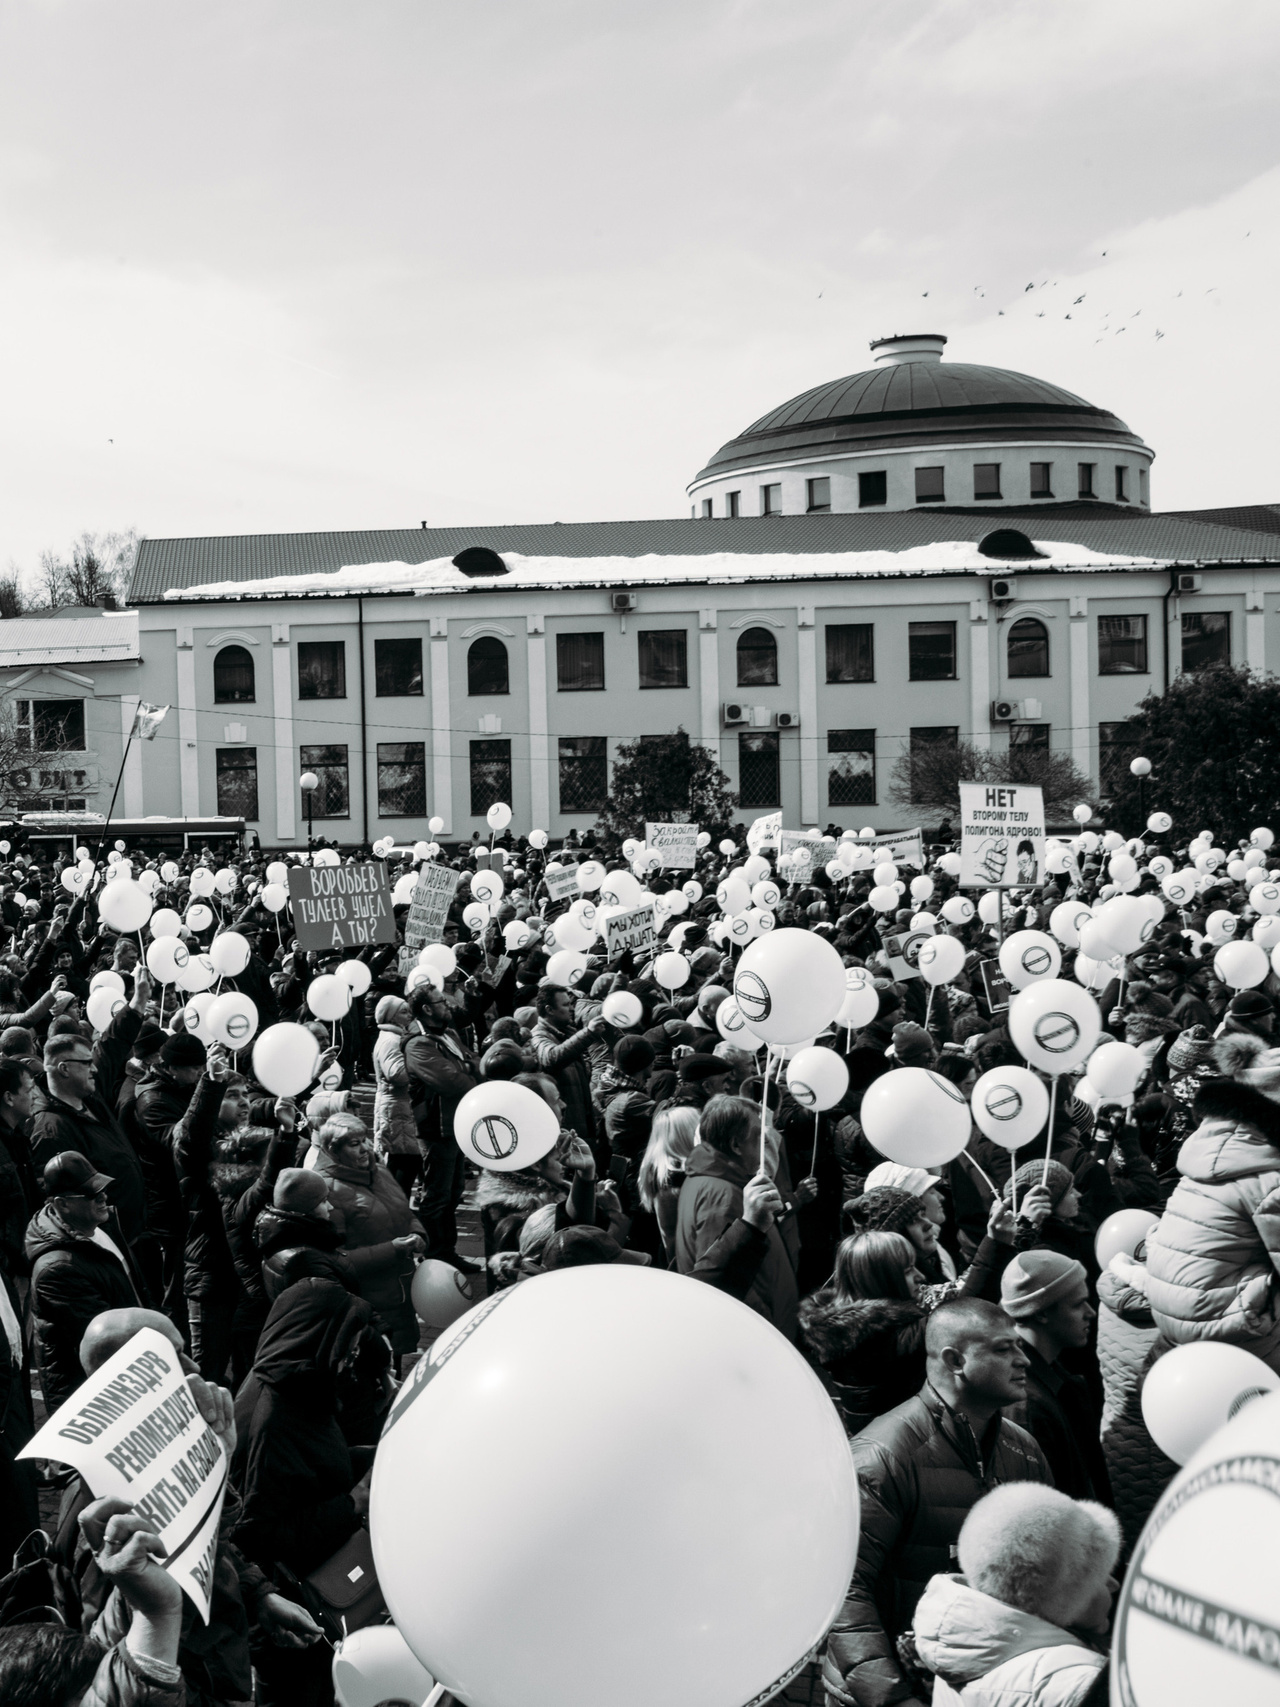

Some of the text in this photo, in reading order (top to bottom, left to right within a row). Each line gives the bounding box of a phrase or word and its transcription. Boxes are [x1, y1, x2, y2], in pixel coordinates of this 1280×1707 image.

[986, 788, 1016, 807] НЕТ
[973, 810, 1029, 821] ВТОРОМУ ТЕЛУ
[965, 825, 1042, 838] ПОЛИГОНА ЯДРОВО!
[299, 897, 347, 923] ТУЛЕЕВ
[351, 894, 387, 918] УШЕЛ
[331, 918, 377, 945] А ТЫ?
[608, 917, 627, 937] МЫ
[612, 926, 657, 955] ДЫШАТЬ
[104, 1384, 199, 1483] РЕКОМЕНДУЕТ
[171, 1458, 201, 1498] НА
